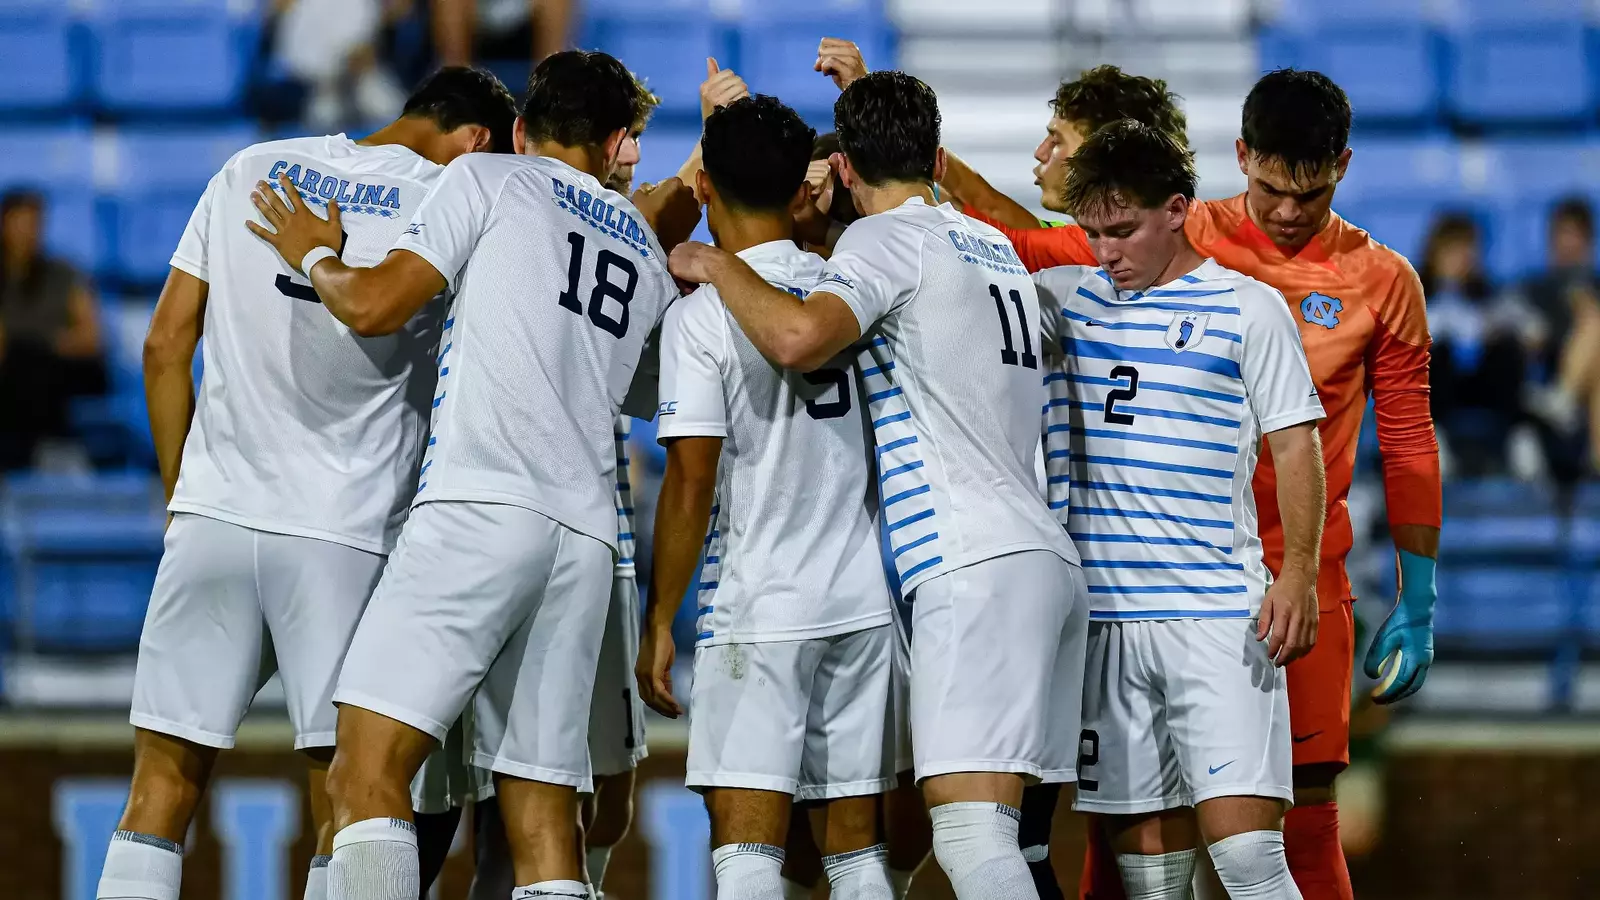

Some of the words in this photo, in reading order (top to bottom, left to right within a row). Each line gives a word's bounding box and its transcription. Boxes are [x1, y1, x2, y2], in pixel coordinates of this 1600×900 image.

[268, 160, 401, 209] CAROLINA
[558, 231, 639, 340] 18
[988, 283, 1038, 370] 11
[1104, 365, 1139, 425] 2
[1077, 728, 1099, 791] 2
